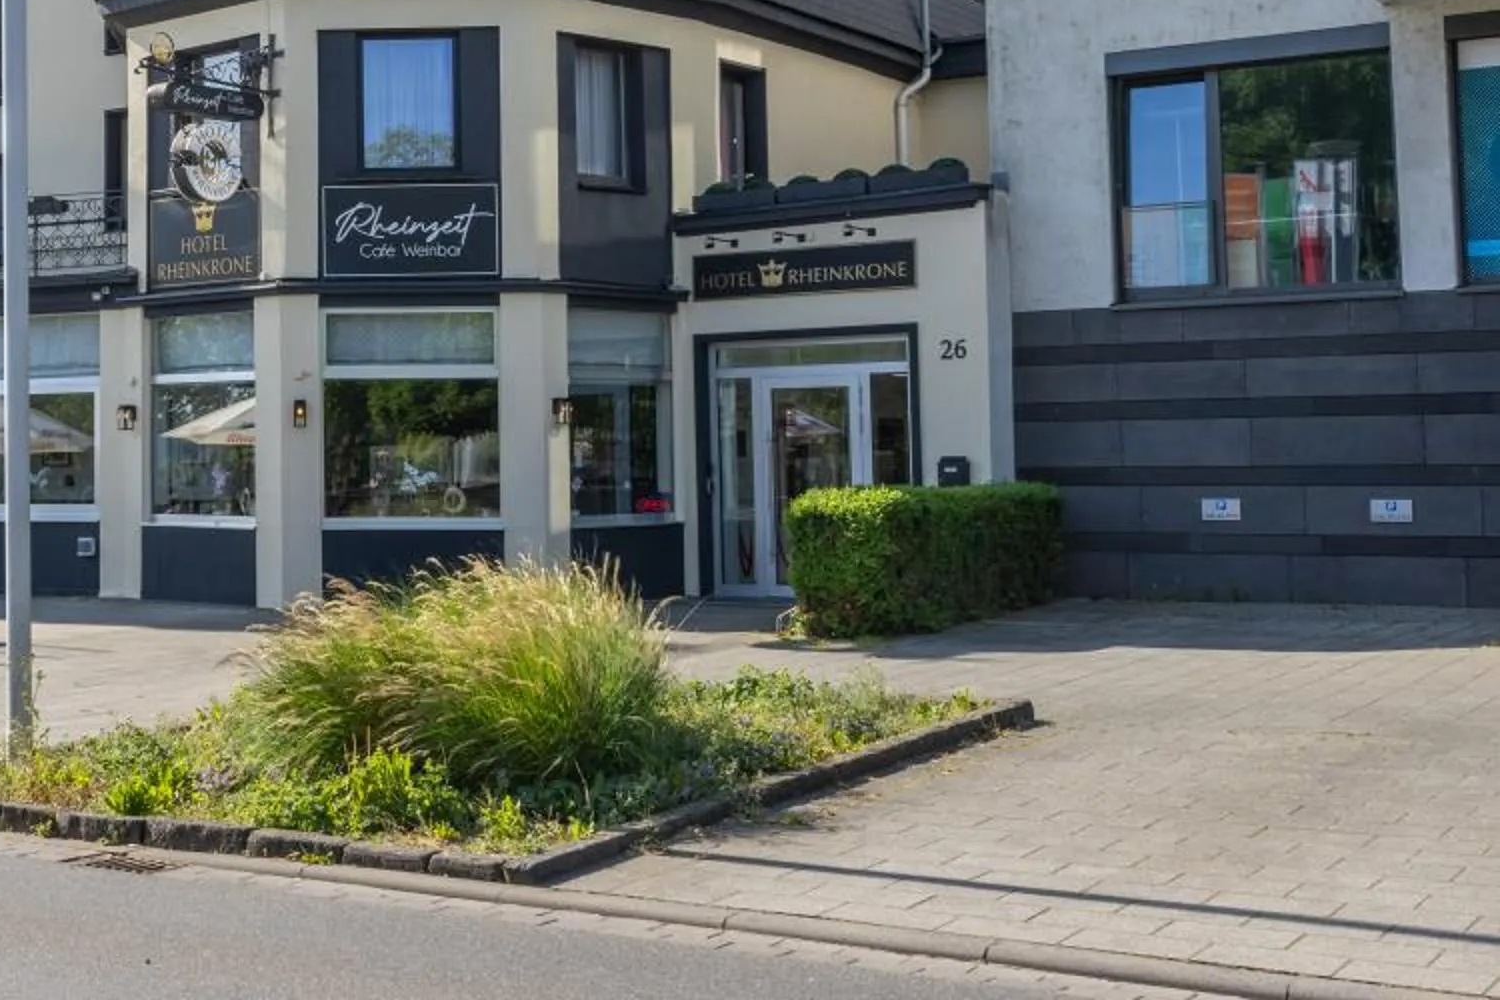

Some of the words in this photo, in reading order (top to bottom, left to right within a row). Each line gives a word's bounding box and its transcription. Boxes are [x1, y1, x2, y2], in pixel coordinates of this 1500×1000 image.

[335, 202, 495, 246] Rheinzeit
[181, 234, 228, 254] HOTEL
[359, 243, 396, 259] Café
[401, 243, 462, 257] Weinbar
[157, 255, 253, 281] RHEINKRONE
[701, 272, 756, 290] HOTEL
[787, 261, 908, 285] RHEINKRONE
[940, 339, 967, 360] 26
